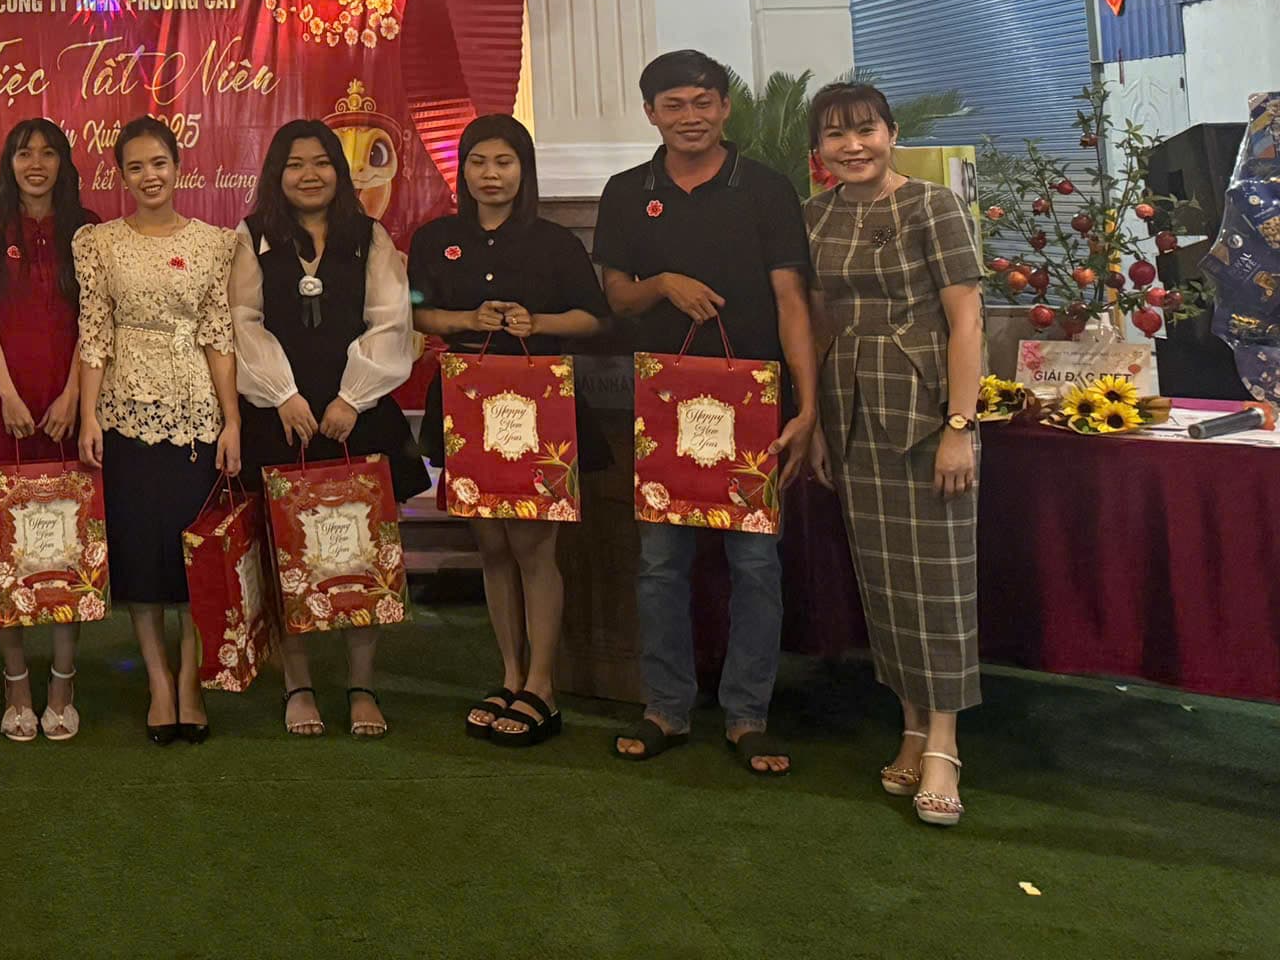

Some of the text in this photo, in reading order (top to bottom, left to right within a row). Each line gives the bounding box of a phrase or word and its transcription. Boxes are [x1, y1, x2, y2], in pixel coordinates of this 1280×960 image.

[57, 36, 145, 100] Tất
[145, 36, 281, 106] Niên
[83, 119, 122, 154] Xuâ
[148, 113, 202, 150] 25
[92, 160, 118, 191] kết
[173, 172, 207, 189] ước
[215, 170, 258, 204] tương
[1034, 369, 1061, 382] GIẢI
[490, 404, 528, 420] Happy
[685, 409, 725, 425] Happy
[499, 419, 523, 430] New
[694, 424, 719, 435] New
[497, 428, 522, 444] Year
[692, 434, 719, 449] Year
